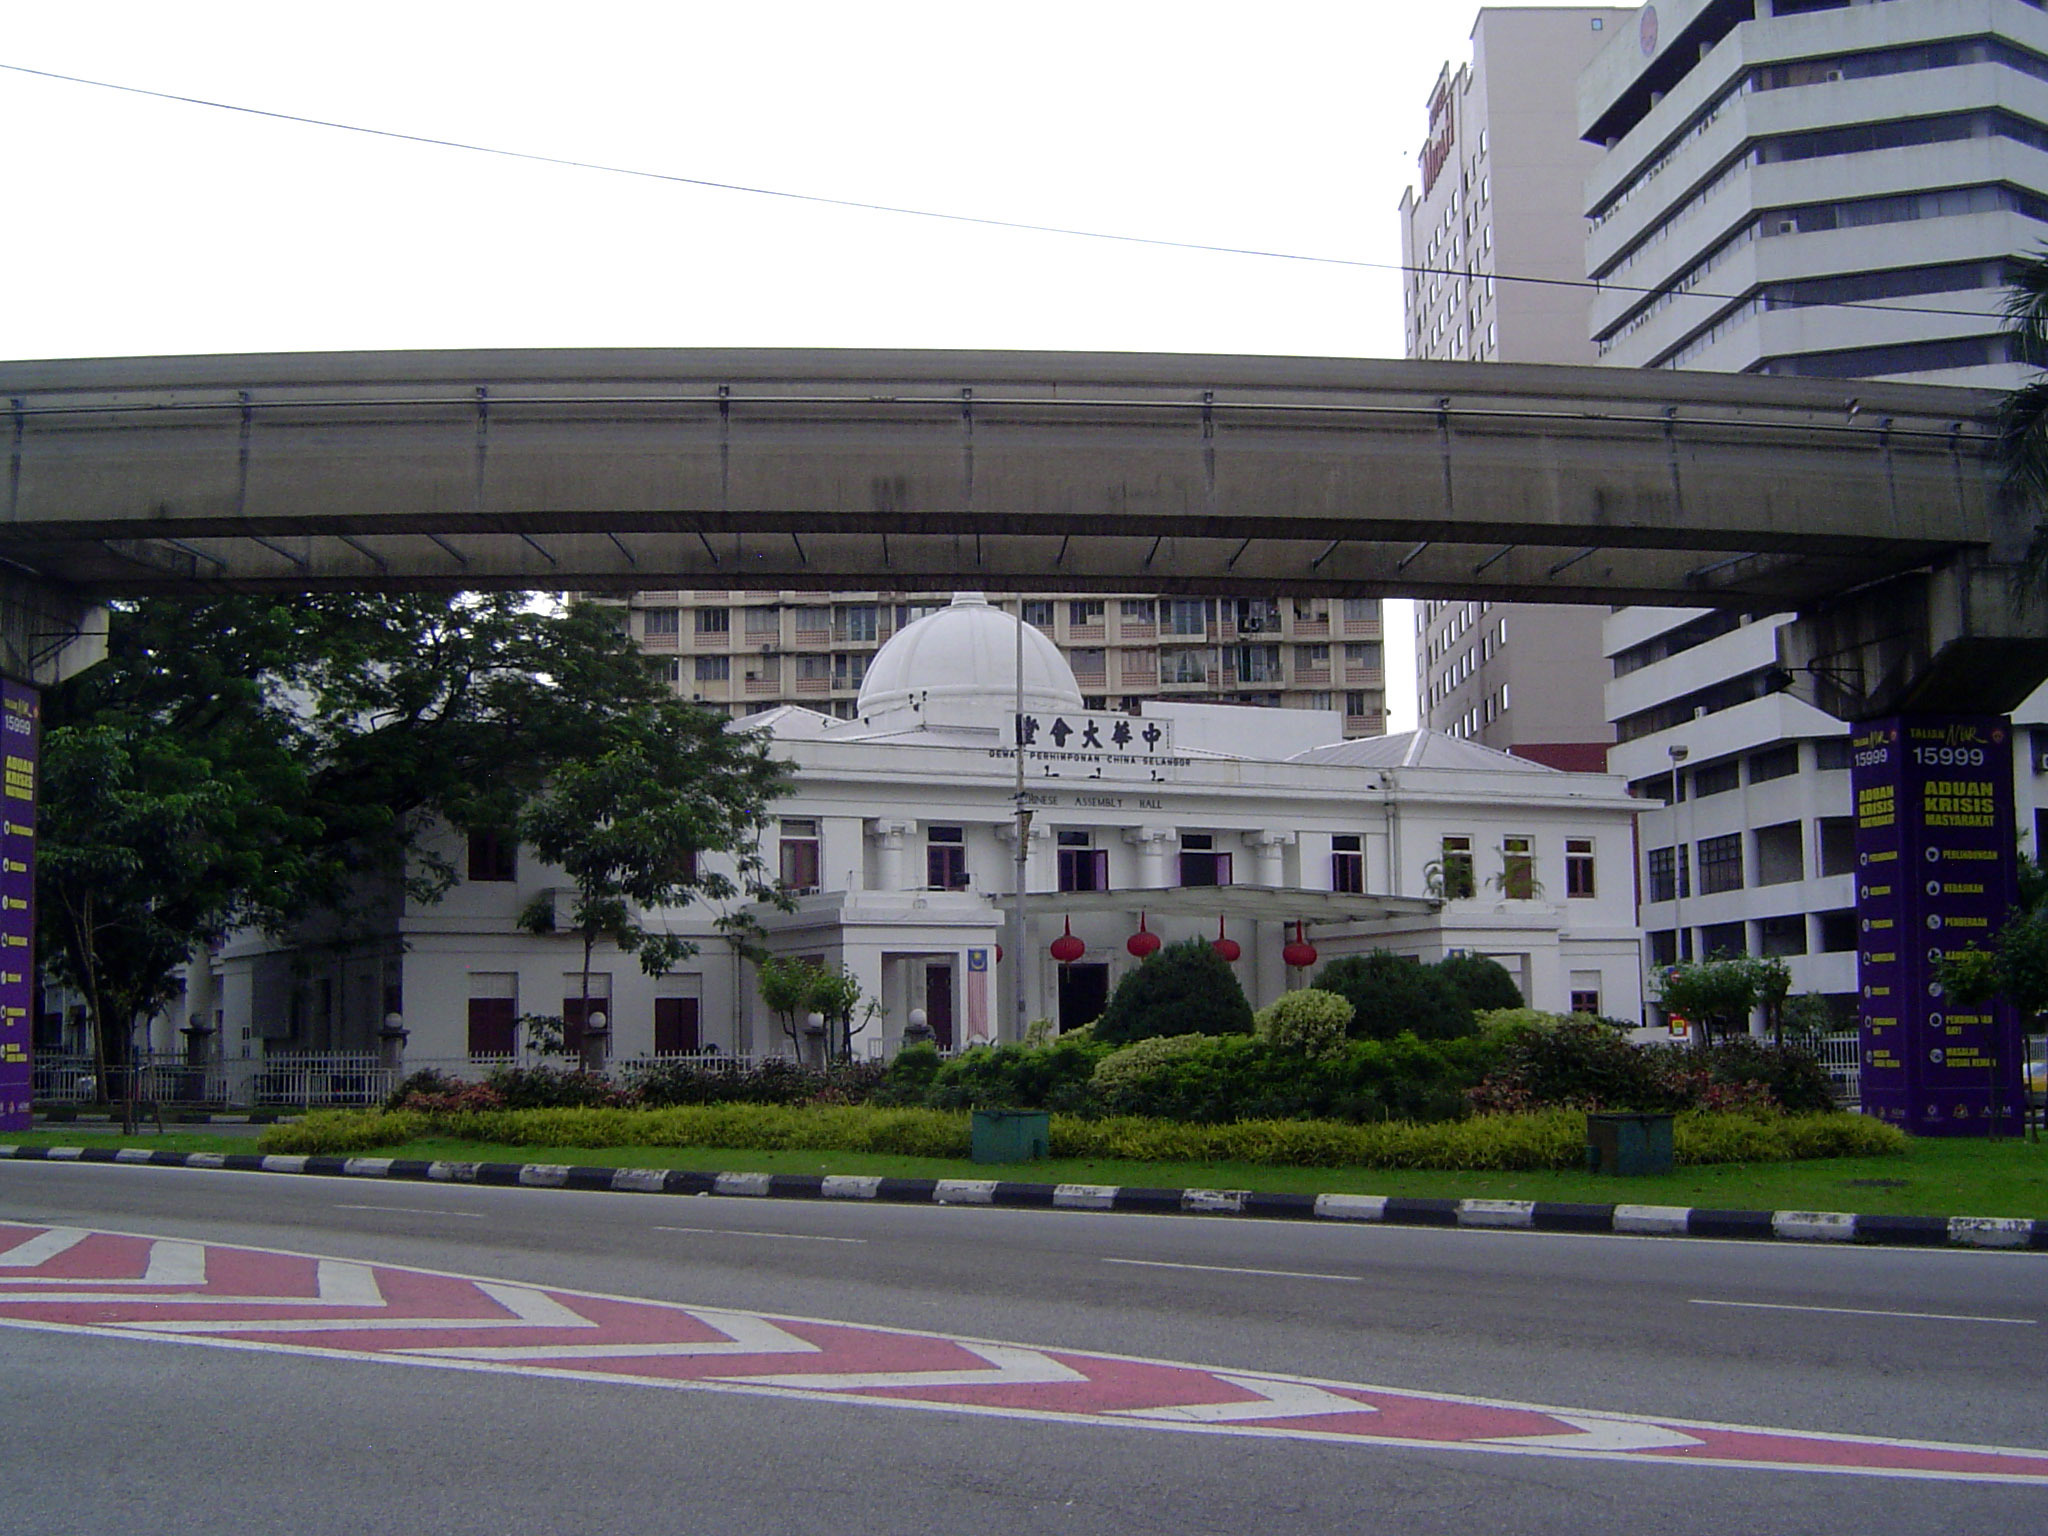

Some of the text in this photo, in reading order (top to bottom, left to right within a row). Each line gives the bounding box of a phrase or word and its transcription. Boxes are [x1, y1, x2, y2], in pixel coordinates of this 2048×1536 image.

[5, 714, 31, 735] 15999
[1107, 755, 1136, 765] CHINA
[1143, 756, 1191, 767] SELANGOR
[1854, 748, 1888, 767] 15999
[1912, 746, 1985, 767] 15999
[1859, 785, 1895, 804] ADUAN
[1924, 781, 1993, 797] ADUAN
[1074, 797, 1123, 809] ASSEMBLY
[1139, 799, 1164, 810] HALL
[1859, 799, 1896, 818] KRISIS
[1924, 797, 1994, 813] KRISIS
[1925, 813, 1995, 827] MASYARAKAT
